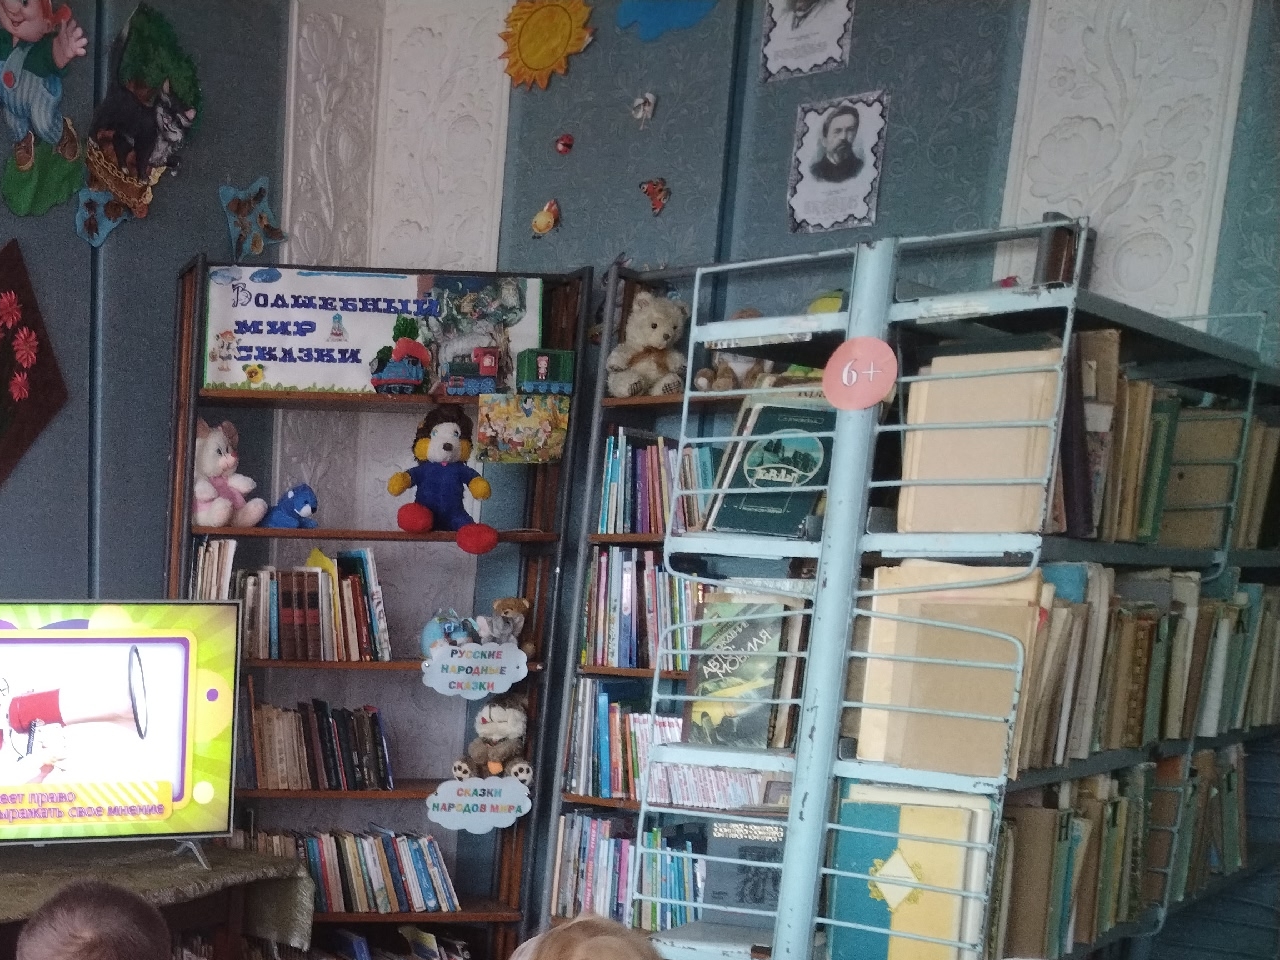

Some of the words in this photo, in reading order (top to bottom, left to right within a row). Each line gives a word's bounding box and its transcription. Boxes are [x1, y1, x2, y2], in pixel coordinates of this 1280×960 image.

[234, 320, 317, 337] МИР
[235, 345, 362, 364] СКАЗКИ
[842, 358, 882, 387] 6+
[450, 649, 503, 659] РУССКИЕ
[440, 664, 507, 676] НАРОДНЫЕ
[448, 681, 495, 691] СКАЗКИ
[28, 791, 76, 805] право
[456, 788, 502, 798] СКАЗКИ
[68, 804, 104, 817] свое
[107, 803, 165, 816] мнение
[432, 803, 487, 813] НАРОДОВ
[490, 804, 523, 814] МИРА
